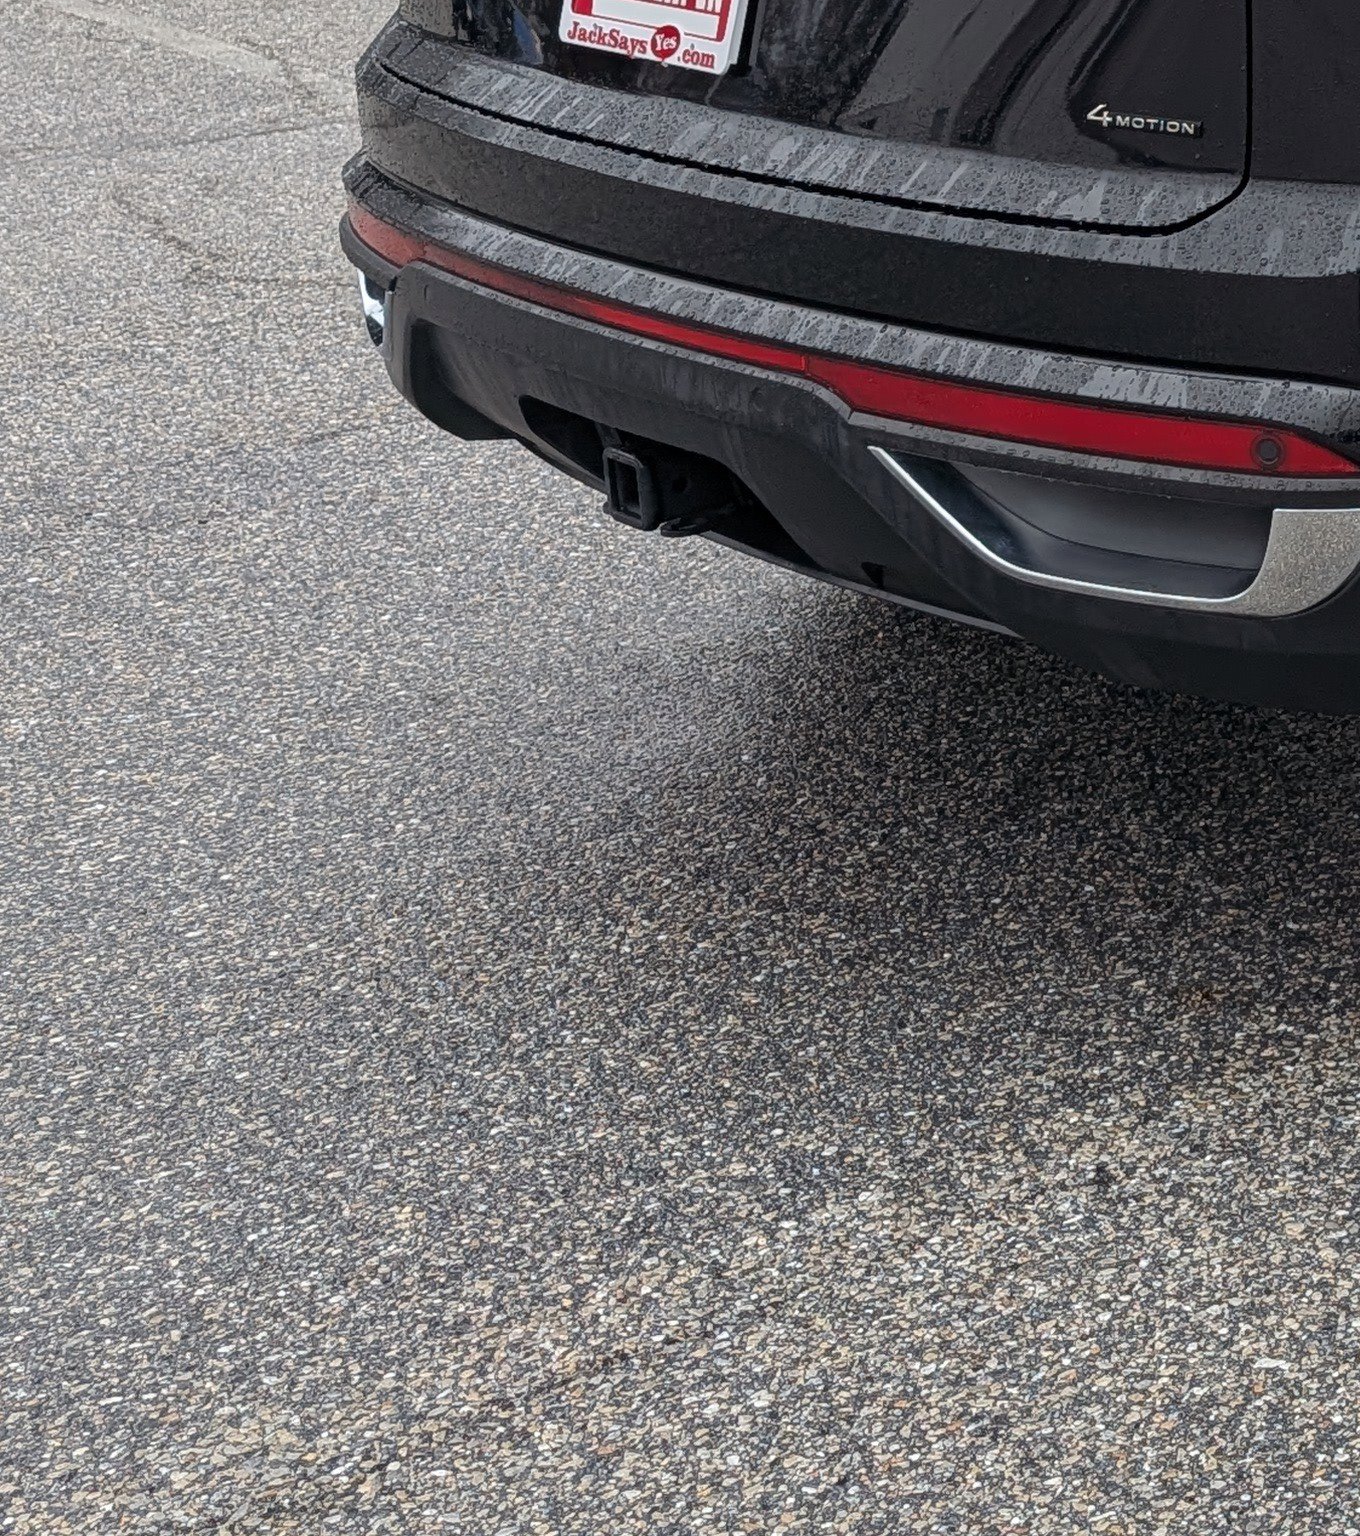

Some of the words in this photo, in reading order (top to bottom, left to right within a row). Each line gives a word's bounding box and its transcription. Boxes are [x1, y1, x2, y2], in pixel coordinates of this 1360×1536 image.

[567, 21, 648, 55] JackSays
[654, 33, 678, 51] Yes
[1087, 103, 1195, 135] 4MOTION
